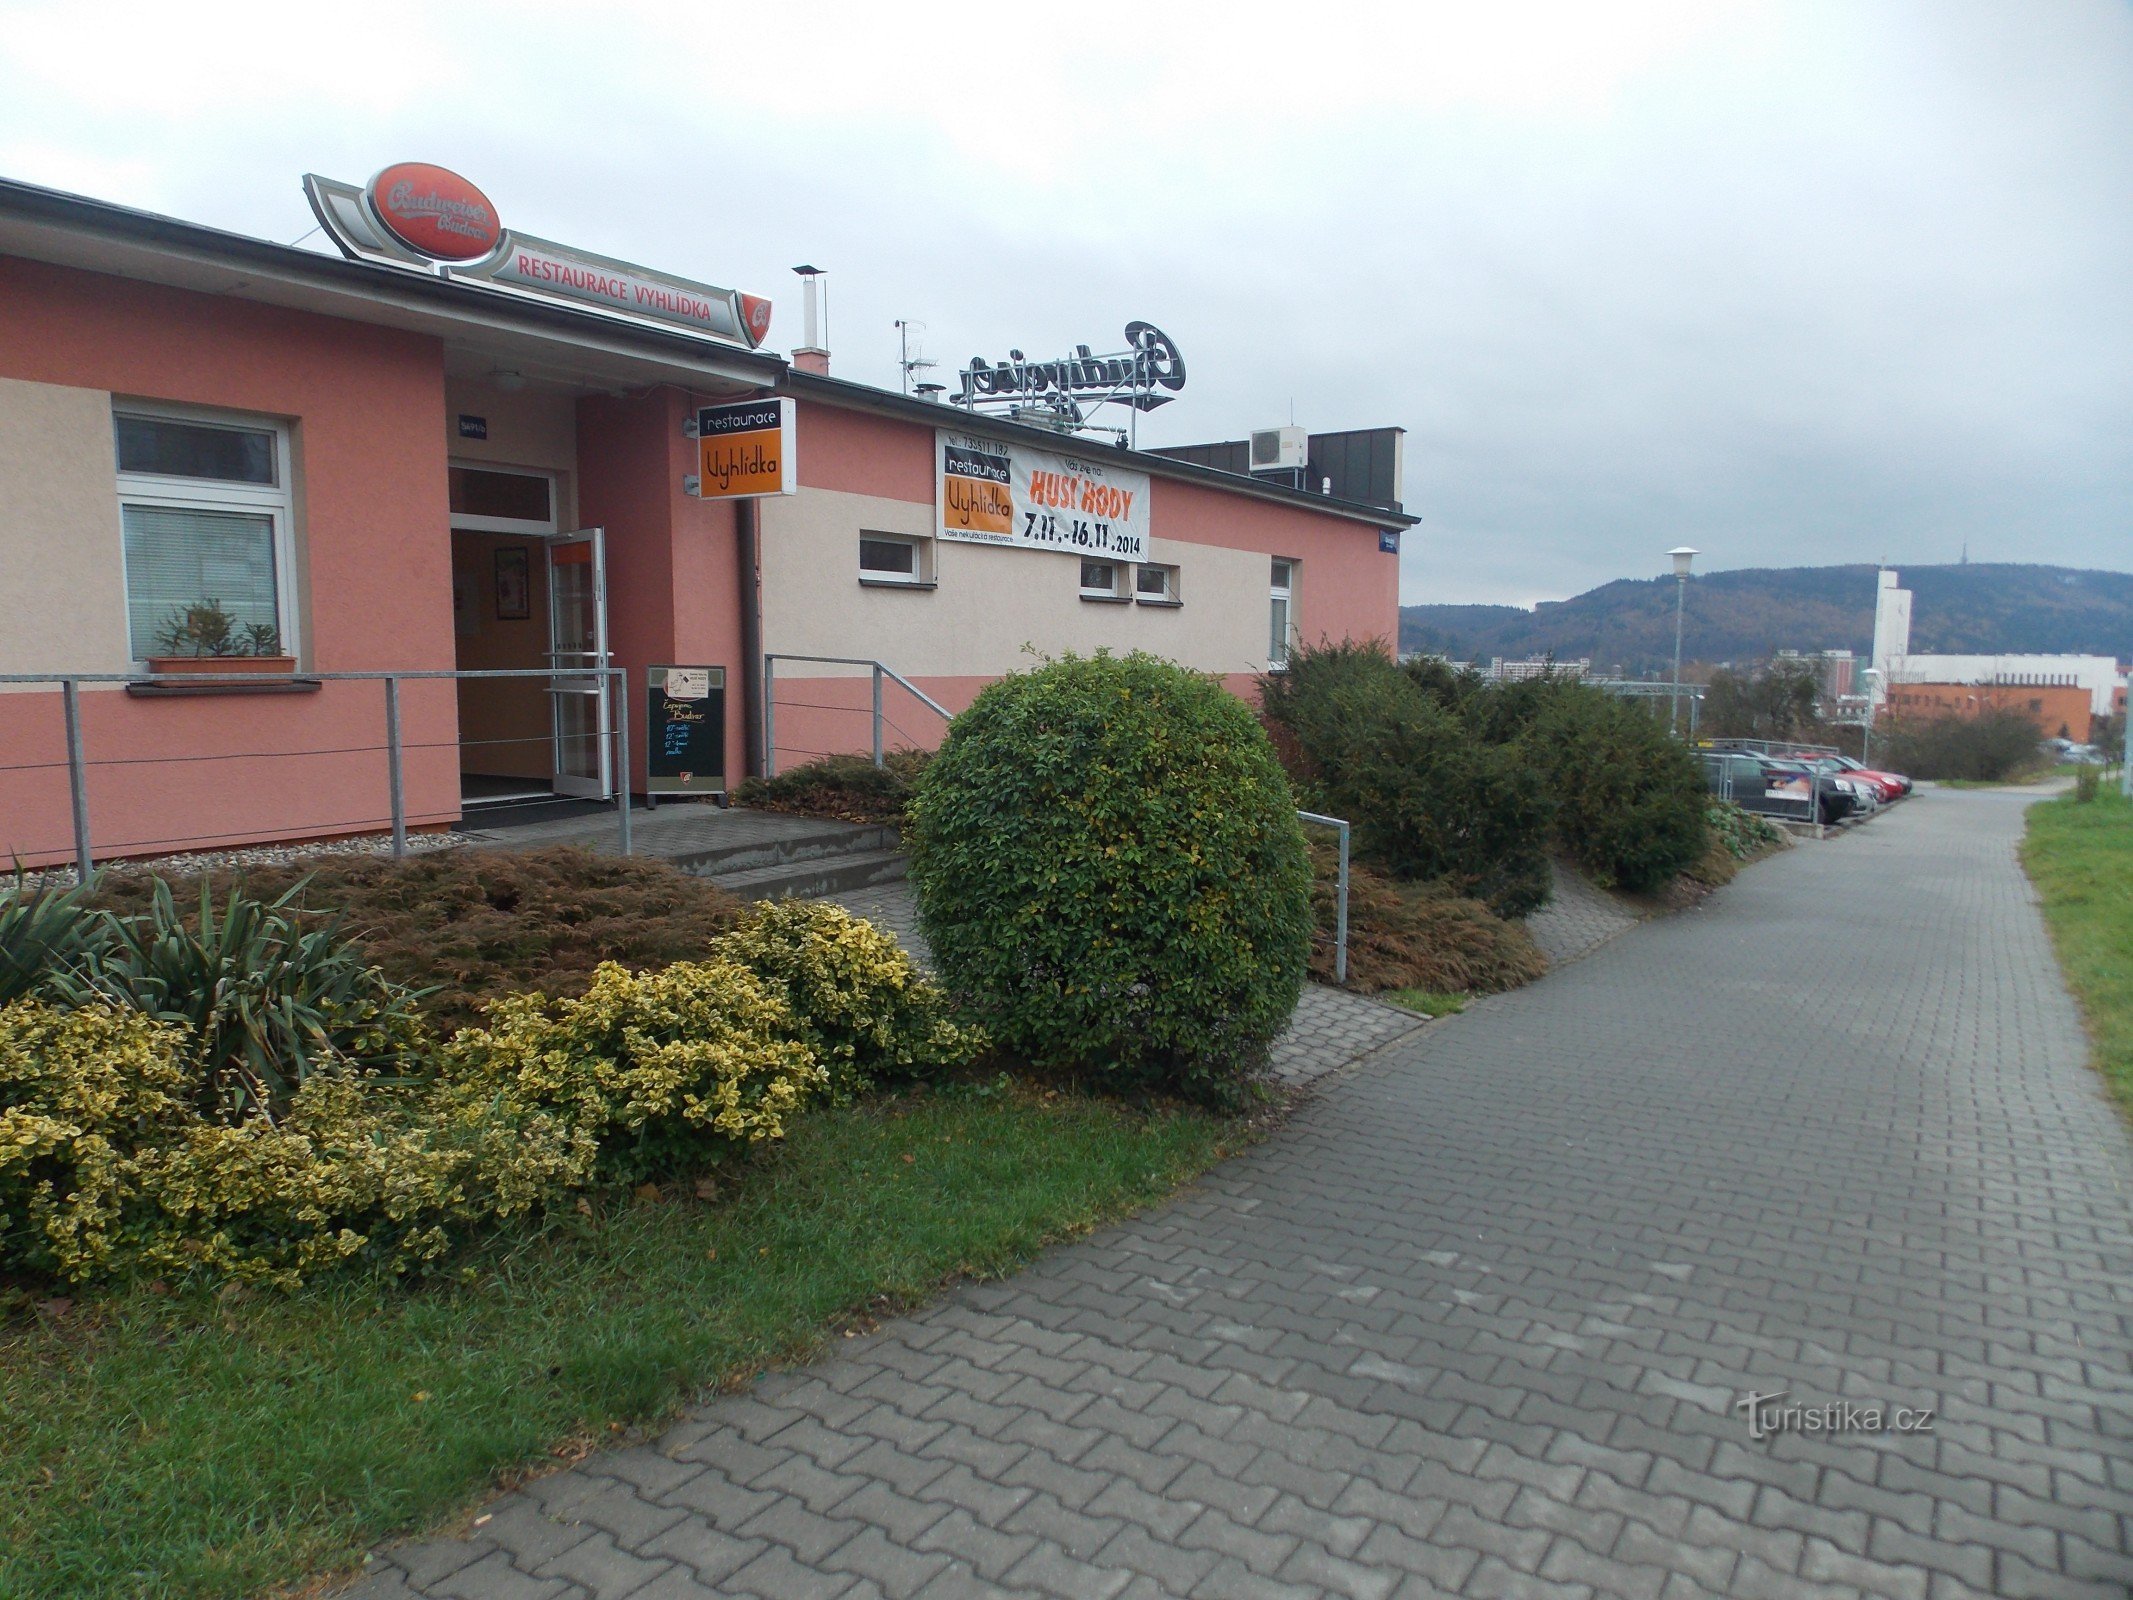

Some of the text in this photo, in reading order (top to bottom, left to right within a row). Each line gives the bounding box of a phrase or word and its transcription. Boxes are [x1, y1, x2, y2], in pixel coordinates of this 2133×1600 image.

[387, 179, 488, 220] Budweiser
[518, 254, 712, 322] RESTAURACE VYHLÍDKA
[707, 412, 776, 430] restaurace
[707, 445, 777, 490] Vyhlídka
[949, 459, 1007, 480] restaurace
[948, 481, 1010, 525] Vyhlídka
[1030, 470, 1134, 521] HUSÍ HODY
